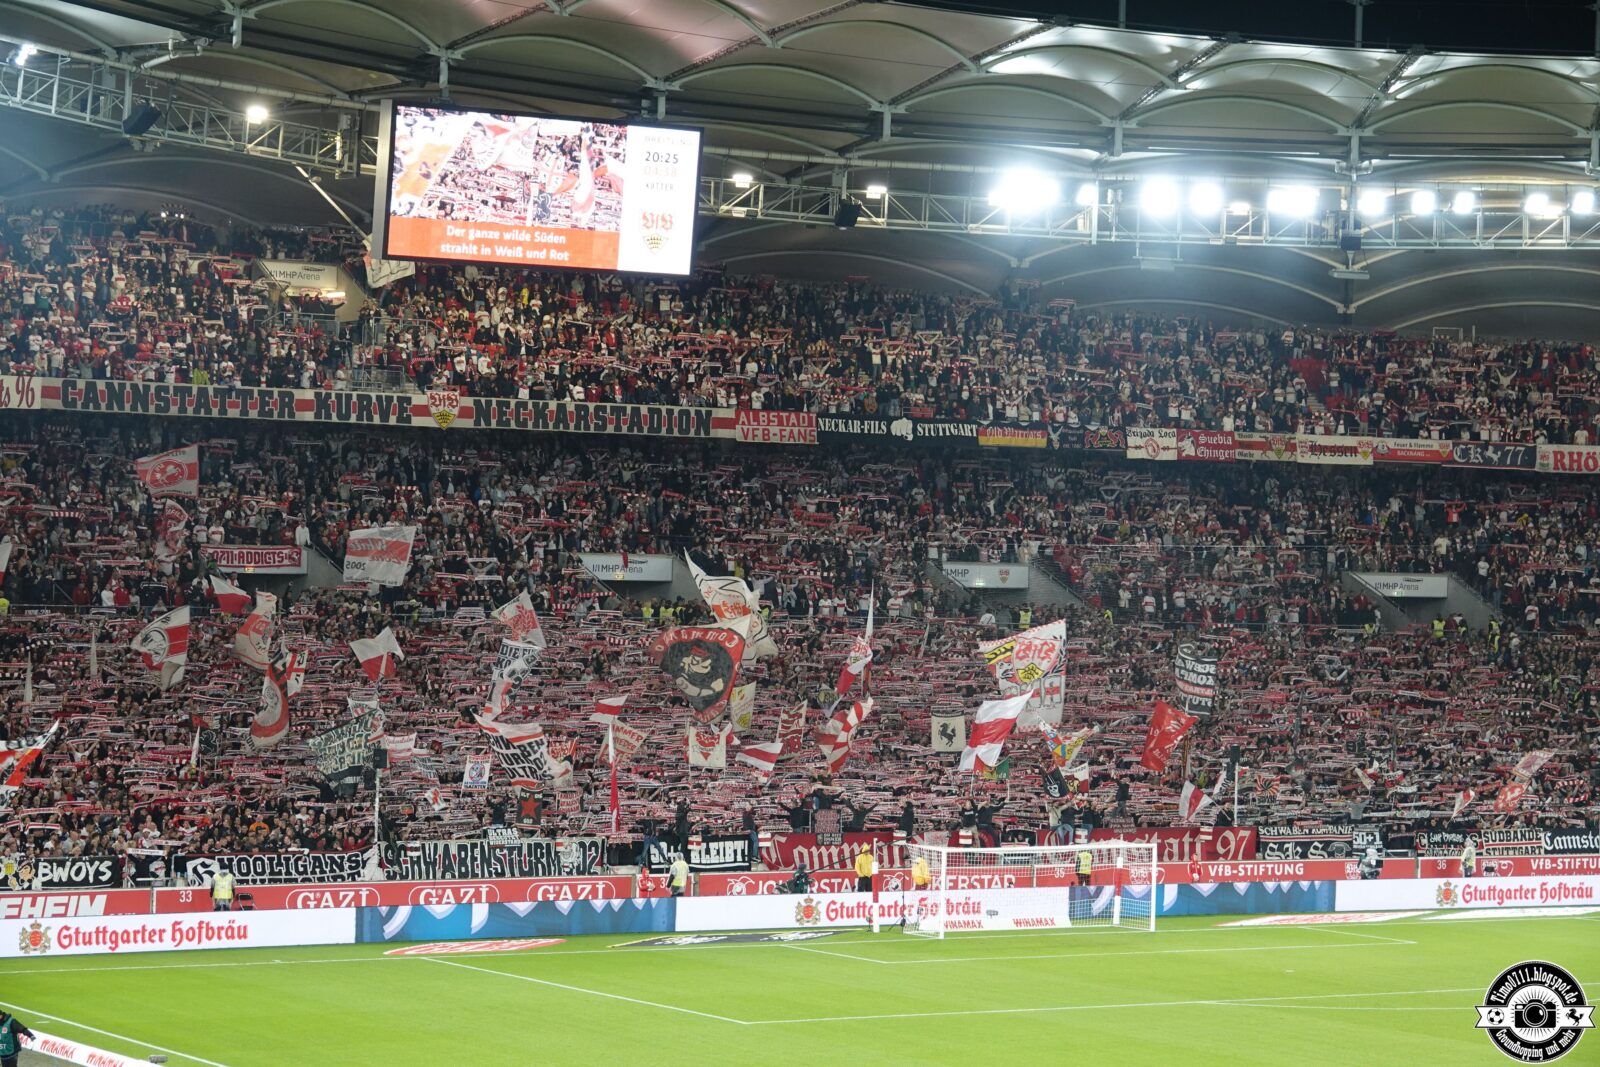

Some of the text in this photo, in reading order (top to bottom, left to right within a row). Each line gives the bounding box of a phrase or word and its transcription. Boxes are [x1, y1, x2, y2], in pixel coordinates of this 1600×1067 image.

[645, 151, 679, 164] 20:25
[446, 225, 566, 244] Der ganze wilde Süden
[440, 243, 570, 261] strahlt in Weiß und Rot
[15, 375, 35, 408] 96
[61, 379, 412, 424] CANNSTATTER KURVE
[474, 399, 711, 437] NECKARSTADION
[738, 411, 817, 427] ALBSTADT
[740, 427, 817, 443] VFB-FANS
[817, 417, 978, 438] NECKAR-FILS STUTTGART
[1504, 446, 1526, 465] 77
[239, 550, 285, 564] ADDICTS
[1216, 829, 1251, 862] 97
[1353, 831, 1382, 845] 50+1
[1485, 846, 1543, 857] STUTTGART
[215, 852, 361, 880] HOOLIGANS
[1208, 863, 1304, 877] VfB-STIFTUNG
[1437, 860, 1447, 870] 36
[1531, 858, 1600, 870] VfB-STIFTU
[1054, 867, 1065, 879] 35
[179, 890, 193, 903] 33
[1462, 881, 1593, 906] Stuttgarter Hofbräu
[918, 896, 982, 920] Hobräu
[1012, 917, 1056, 929] WINAMAX
[57, 919, 249, 952] Stuttgarter Hofbräu
